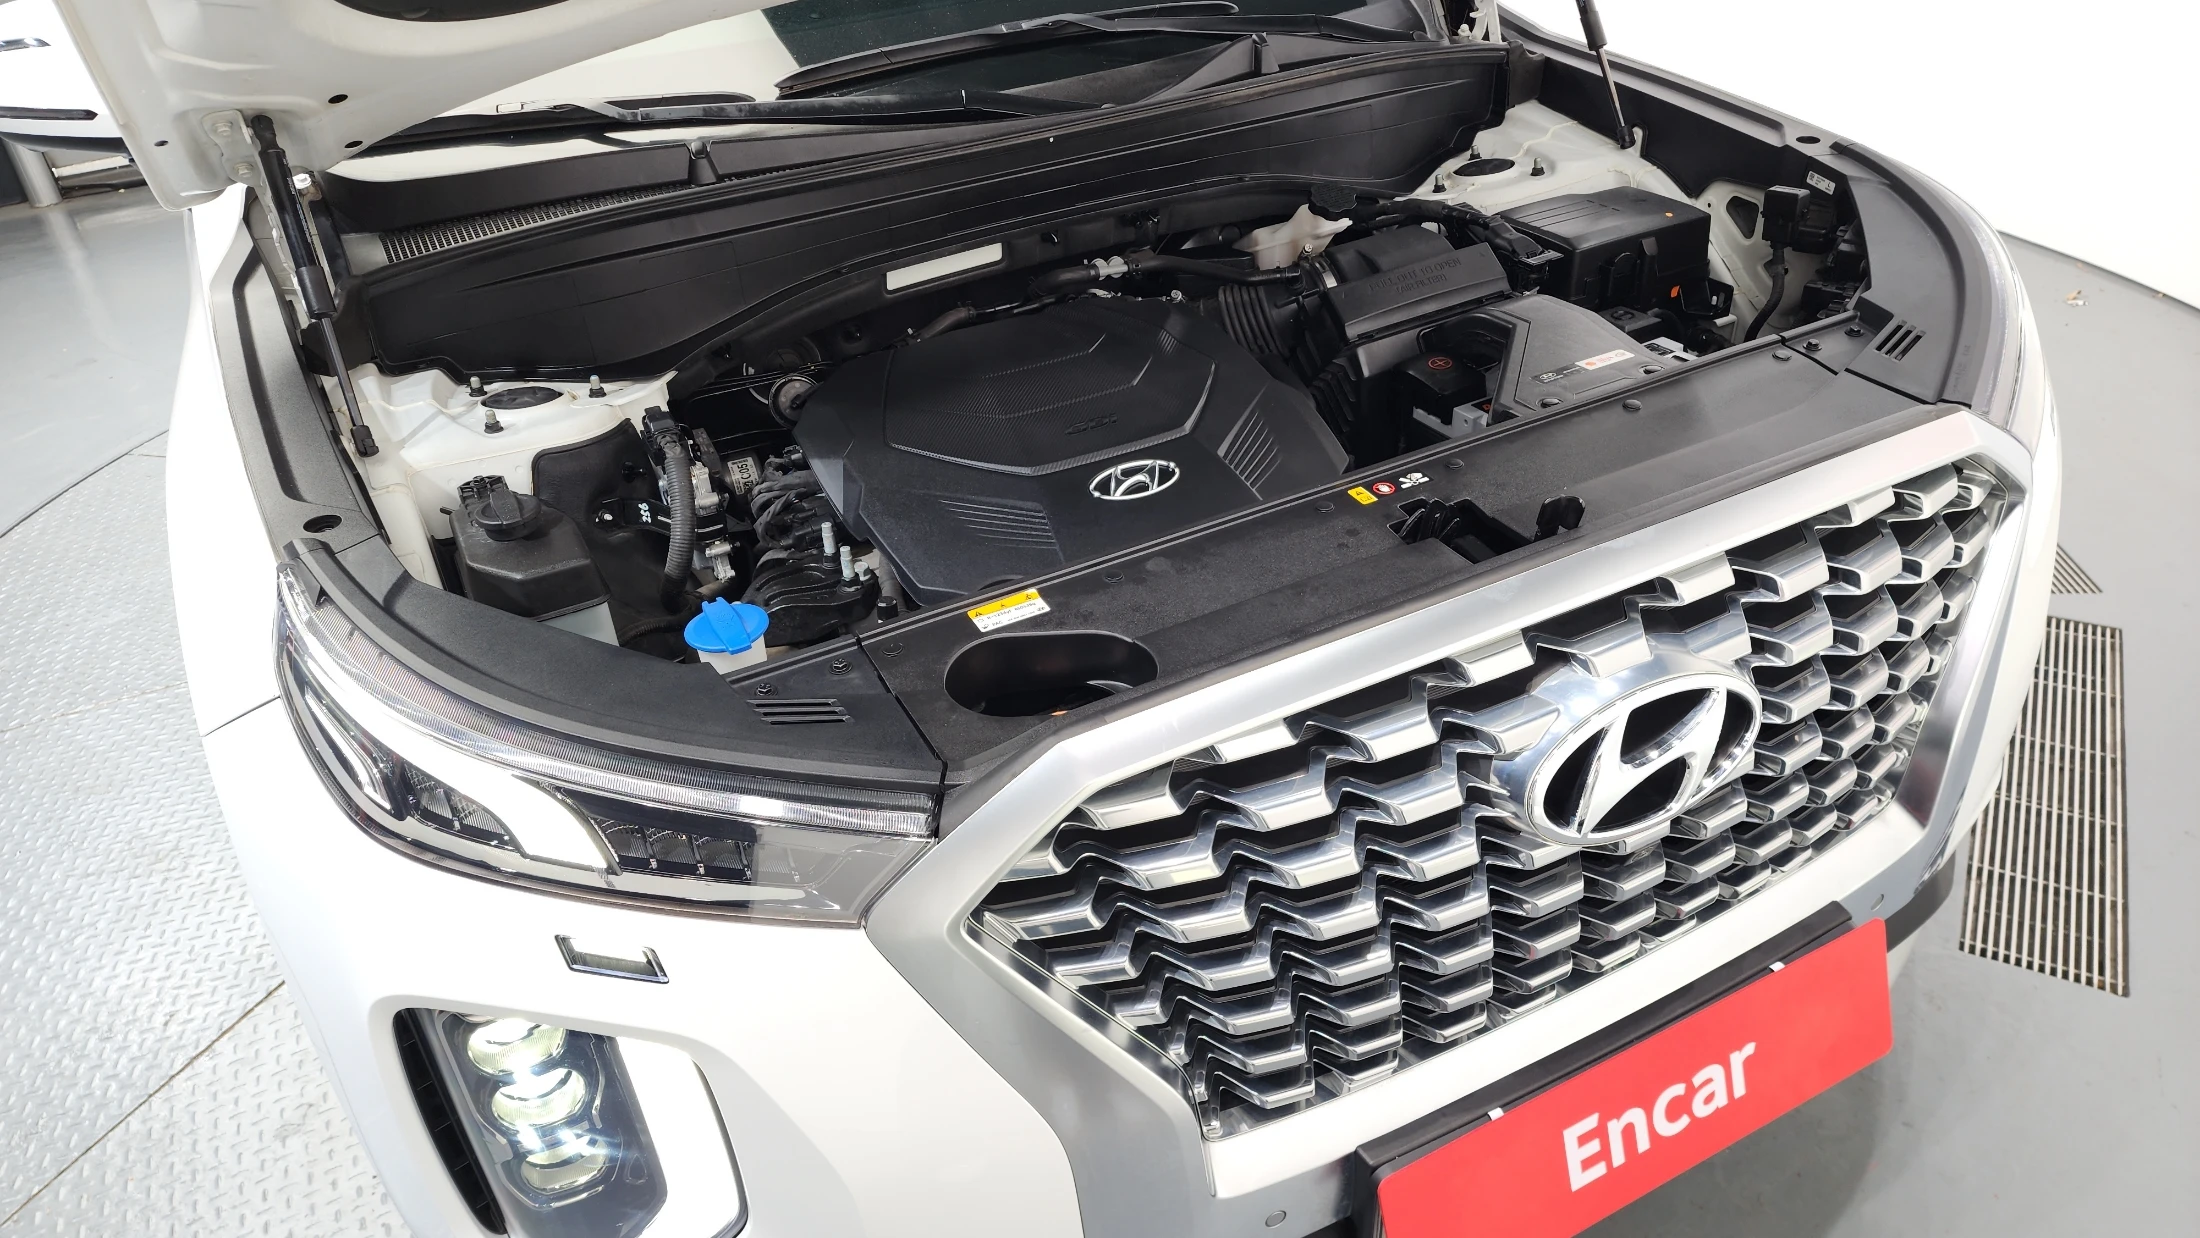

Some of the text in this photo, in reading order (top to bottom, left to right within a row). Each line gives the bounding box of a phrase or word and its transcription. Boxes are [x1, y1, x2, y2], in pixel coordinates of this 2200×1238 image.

[1397, 269, 1417, 282] OUT
[1420, 265, 1434, 276] TO
[1435, 258, 1462, 272] OPEN
[1563, 1041, 1756, 1192] Encar
